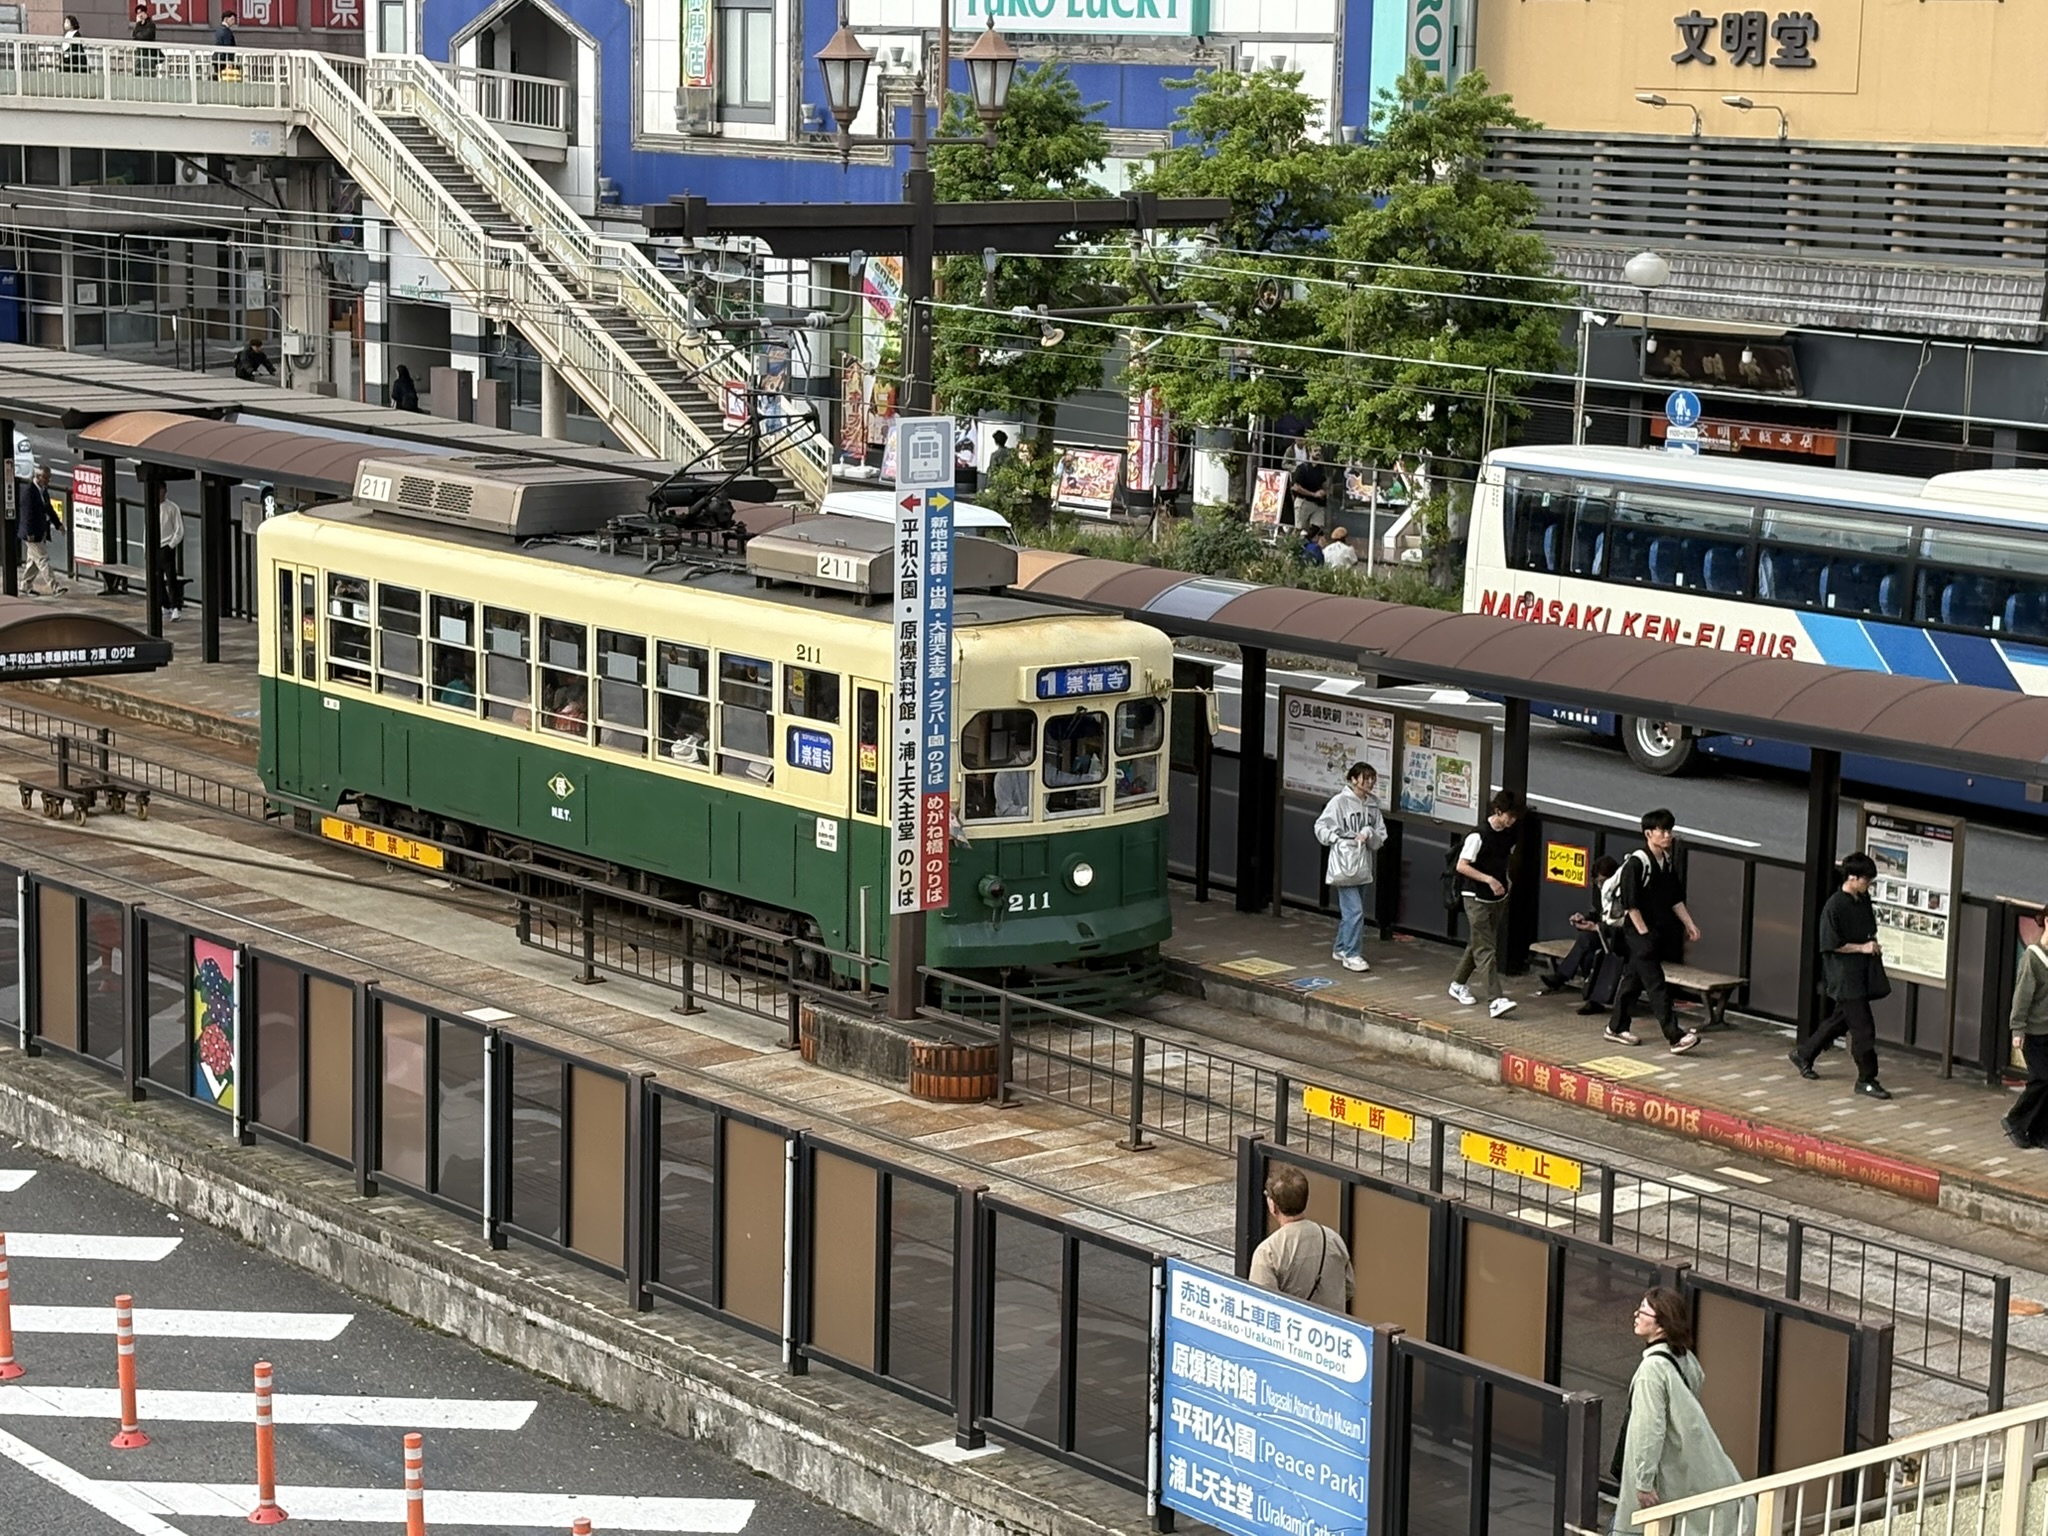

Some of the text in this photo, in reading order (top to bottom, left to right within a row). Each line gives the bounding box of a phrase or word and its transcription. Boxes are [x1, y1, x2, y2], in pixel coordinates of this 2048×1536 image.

[1671, 10, 1818, 68] 文明堂
[874, 261, 900, 295] enjoy
[361, 477, 387, 499] 211
[820, 556, 850, 579] 211
[1479, 589, 1797, 661] NAGASAKI KEN-EI BUS
[90, 647, 107, 660] 方面
[111, 646, 135, 660] のりば
[796, 643, 822, 665] 211
[1041, 671, 1057, 696] 1
[1066, 671, 1125, 694] 崇福寺
[1302, 703, 1342, 723] 長崎駅前
[793, 732, 800, 764] 1
[801, 744, 832, 771] 崇福寺
[927, 751, 945, 785] のりば
[343, 823, 420, 861] 横断禁止
[925, 795, 944, 903] めがね橋 のりば
[898, 849, 915, 907] のりば
[1565, 868, 1584, 881] のりば
[1008, 891, 1051, 912] 211
[1329, 1094, 1385, 1132] 横断
[1513, 1060, 1525, 1082] 3
[1611, 1095, 1638, 1118] 行き
[1643, 1100, 1701, 1133] のりば
[1489, 1141, 1551, 1181] 禁止
[1180, 1280, 1353, 1359] 赤迫・浦上車庫 行 のりば
[1180, 1303, 1196, 1318] For
[1288, 1342, 1313, 1363] Tram
[1316, 1353, 1347, 1376] Depot
[1171, 1341, 1258, 1406] 原爆資料館
[1170, 1397, 1258, 1463] 平和公園
[1168, 1454, 1255, 1521] 浦上天主堂
